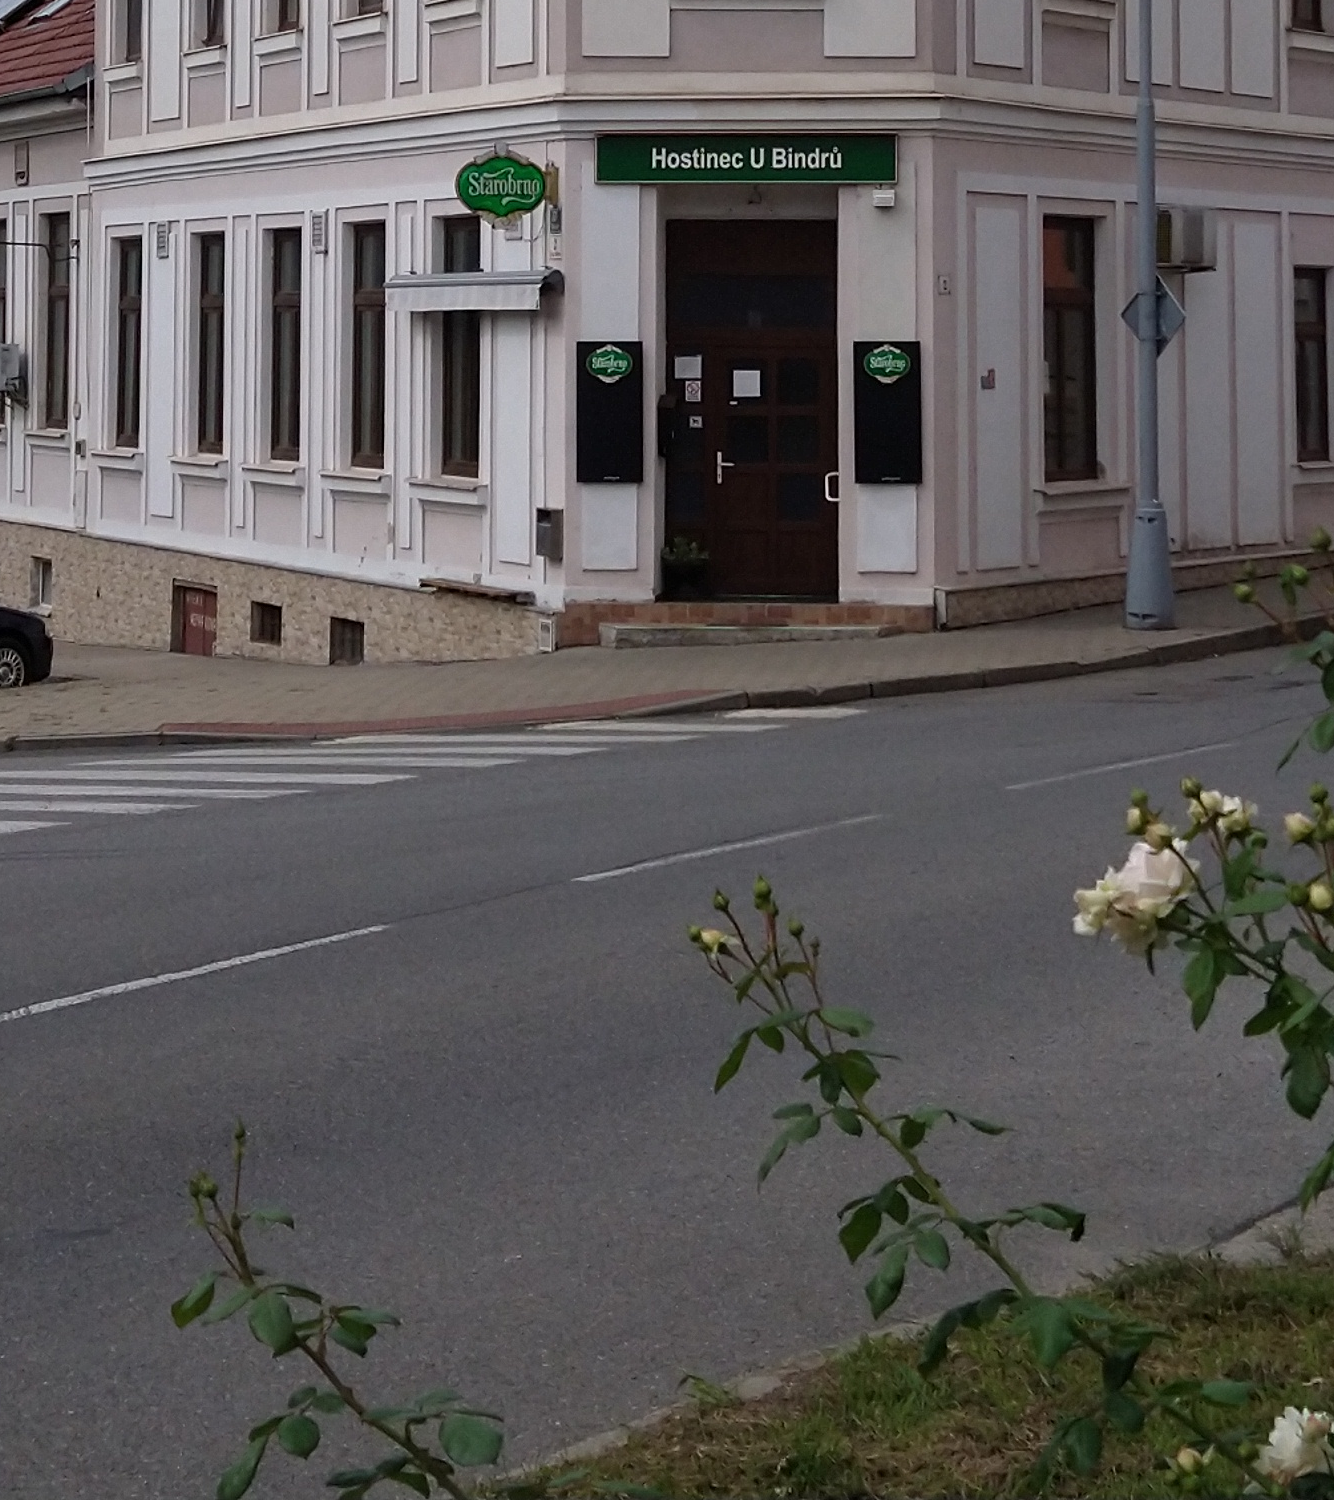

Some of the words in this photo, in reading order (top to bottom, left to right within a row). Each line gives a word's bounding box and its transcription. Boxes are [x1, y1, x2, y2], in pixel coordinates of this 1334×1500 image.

[651, 147, 744, 169] Hostinec
[749, 147, 765, 169] U
[771, 146, 842, 169] Bindrů
[468, 166, 540, 206] Starobrno
